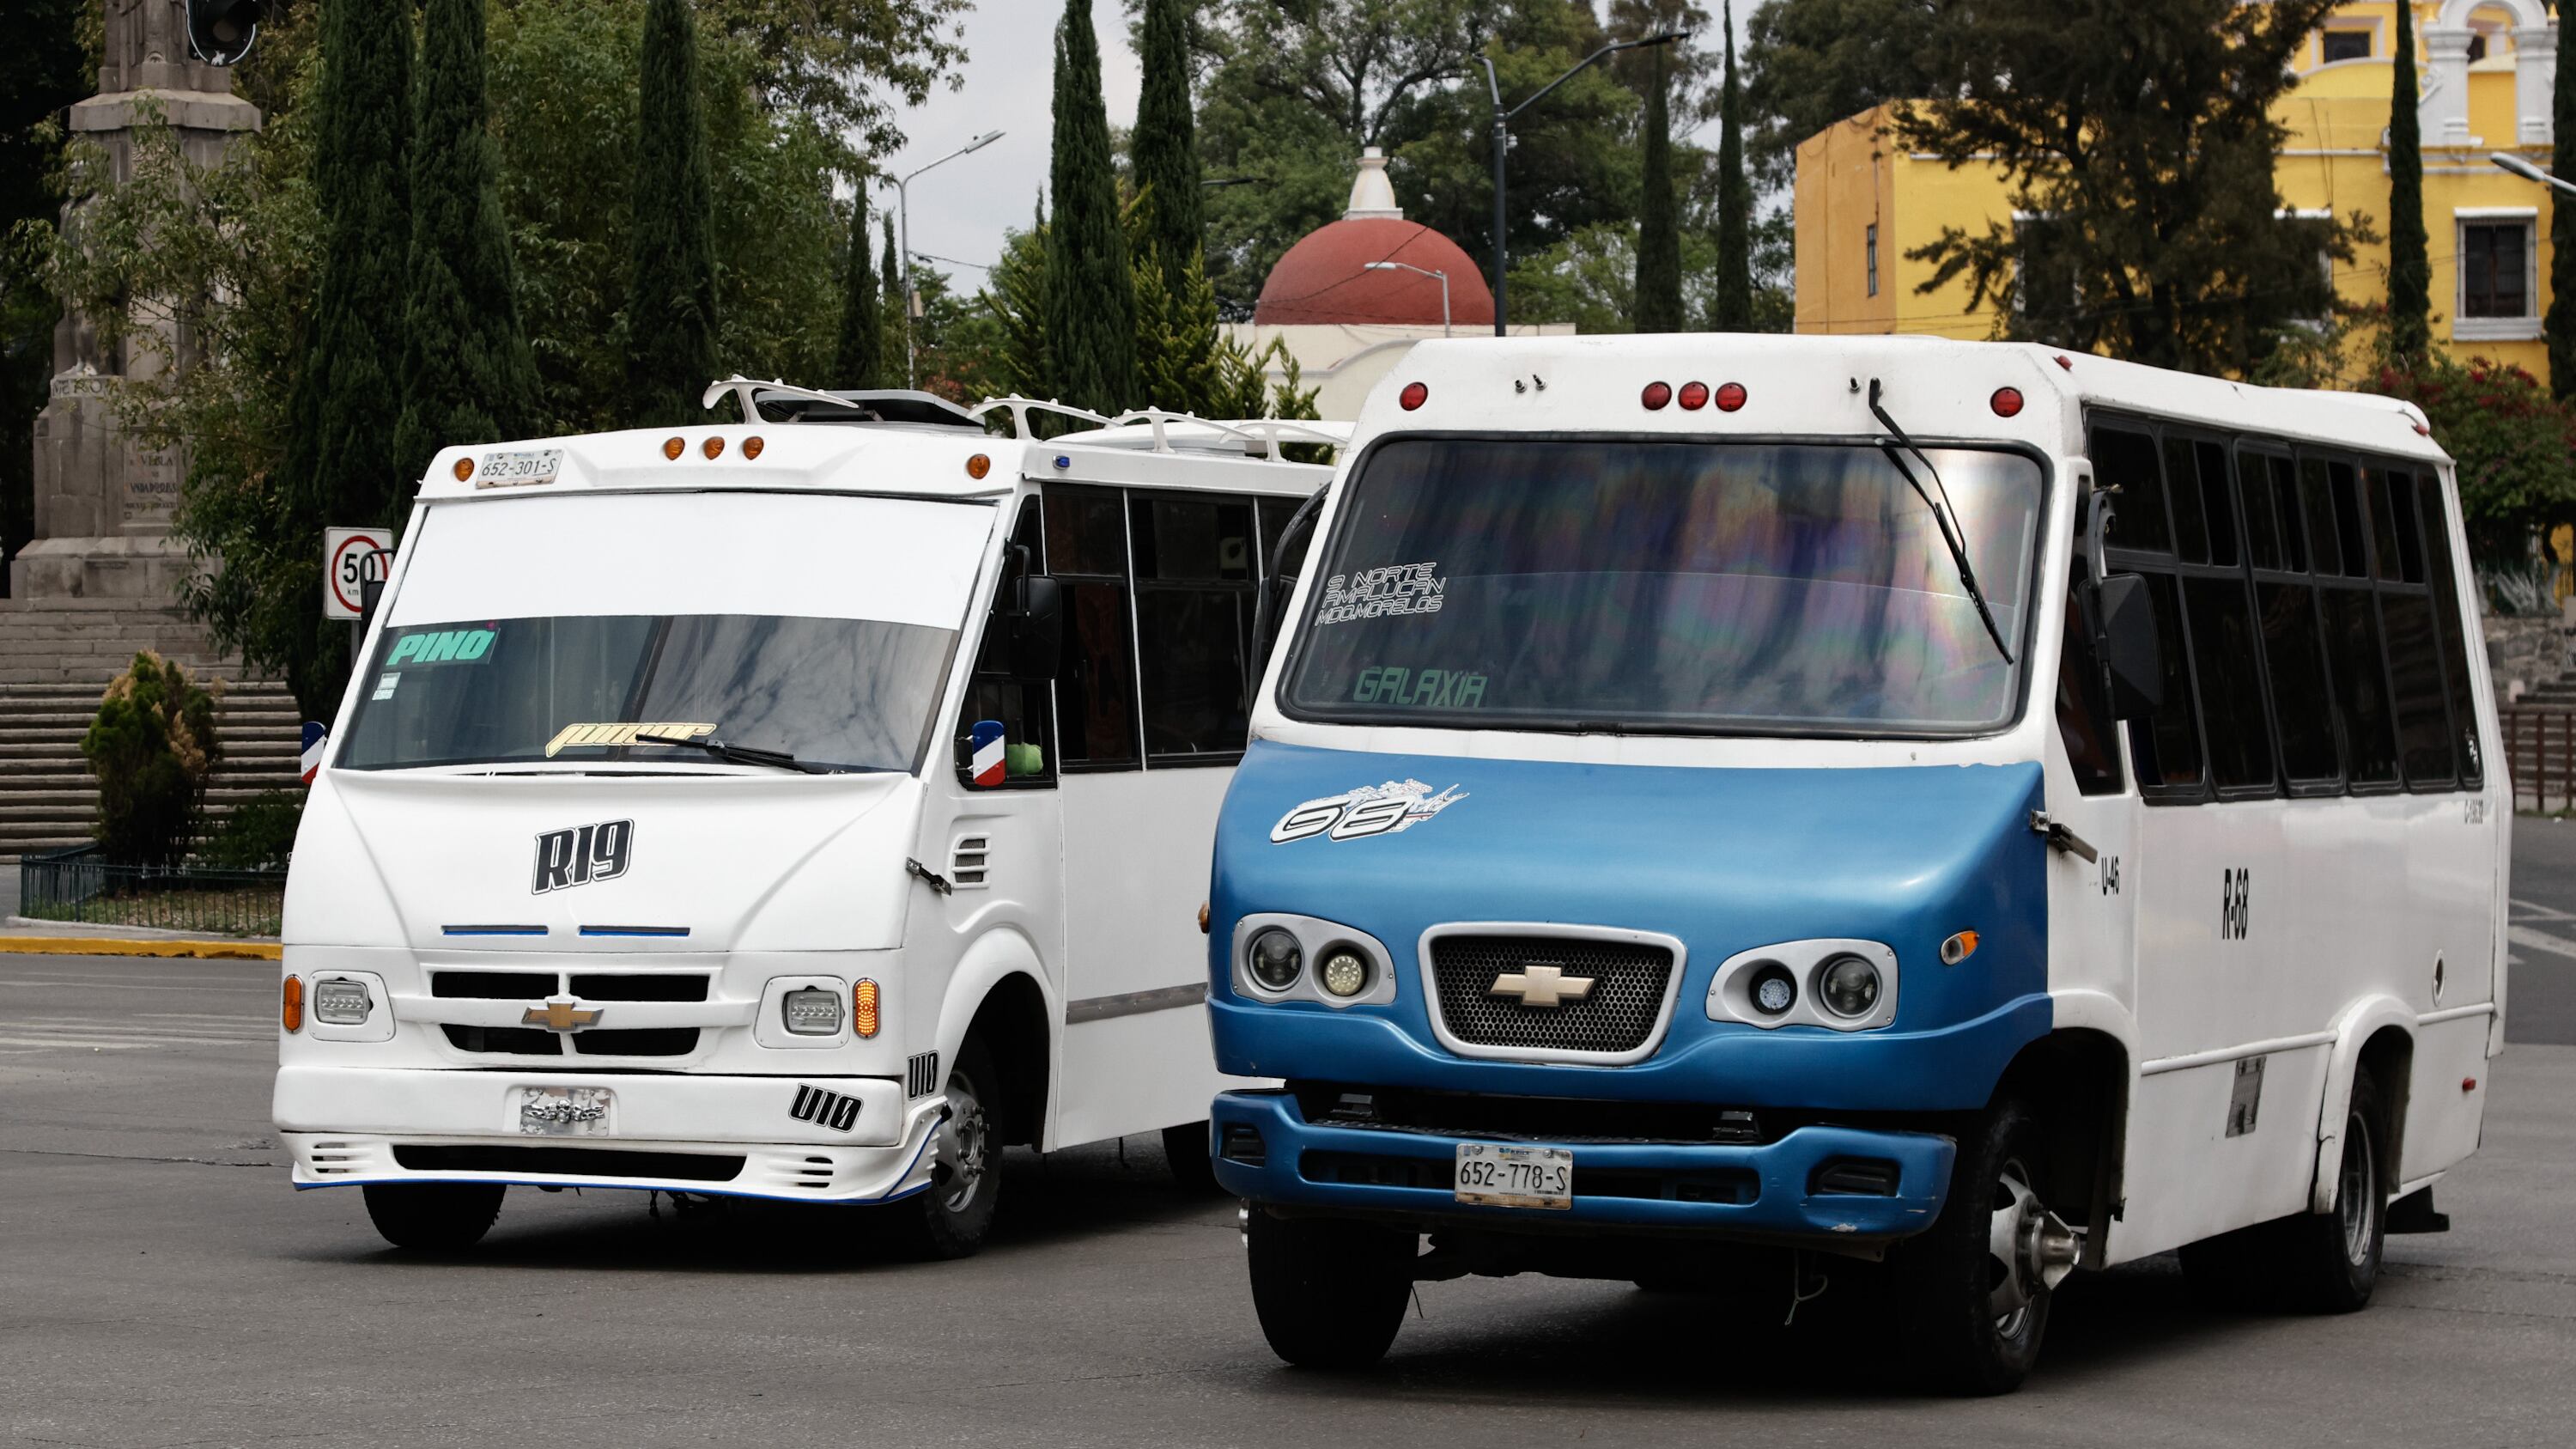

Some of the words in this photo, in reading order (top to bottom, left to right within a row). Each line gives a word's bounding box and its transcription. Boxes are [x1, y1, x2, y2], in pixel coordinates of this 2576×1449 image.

[482, 458, 556, 476] 652-301-S
[1322, 577, 1446, 609] AMALUCAN
[1352, 562, 1437, 588] NORTE
[386, 630, 495, 666] PINO
[1352, 667, 1488, 709] GALAXIA
[1270, 795, 1415, 844] 68
[532, 819, 635, 895] R19
[2101, 855, 2119, 896] U-46
[2222, 868, 2249, 940] R-68
[788, 1083, 864, 1133] U10
[1461, 1161, 1566, 1190] 652-778-S
